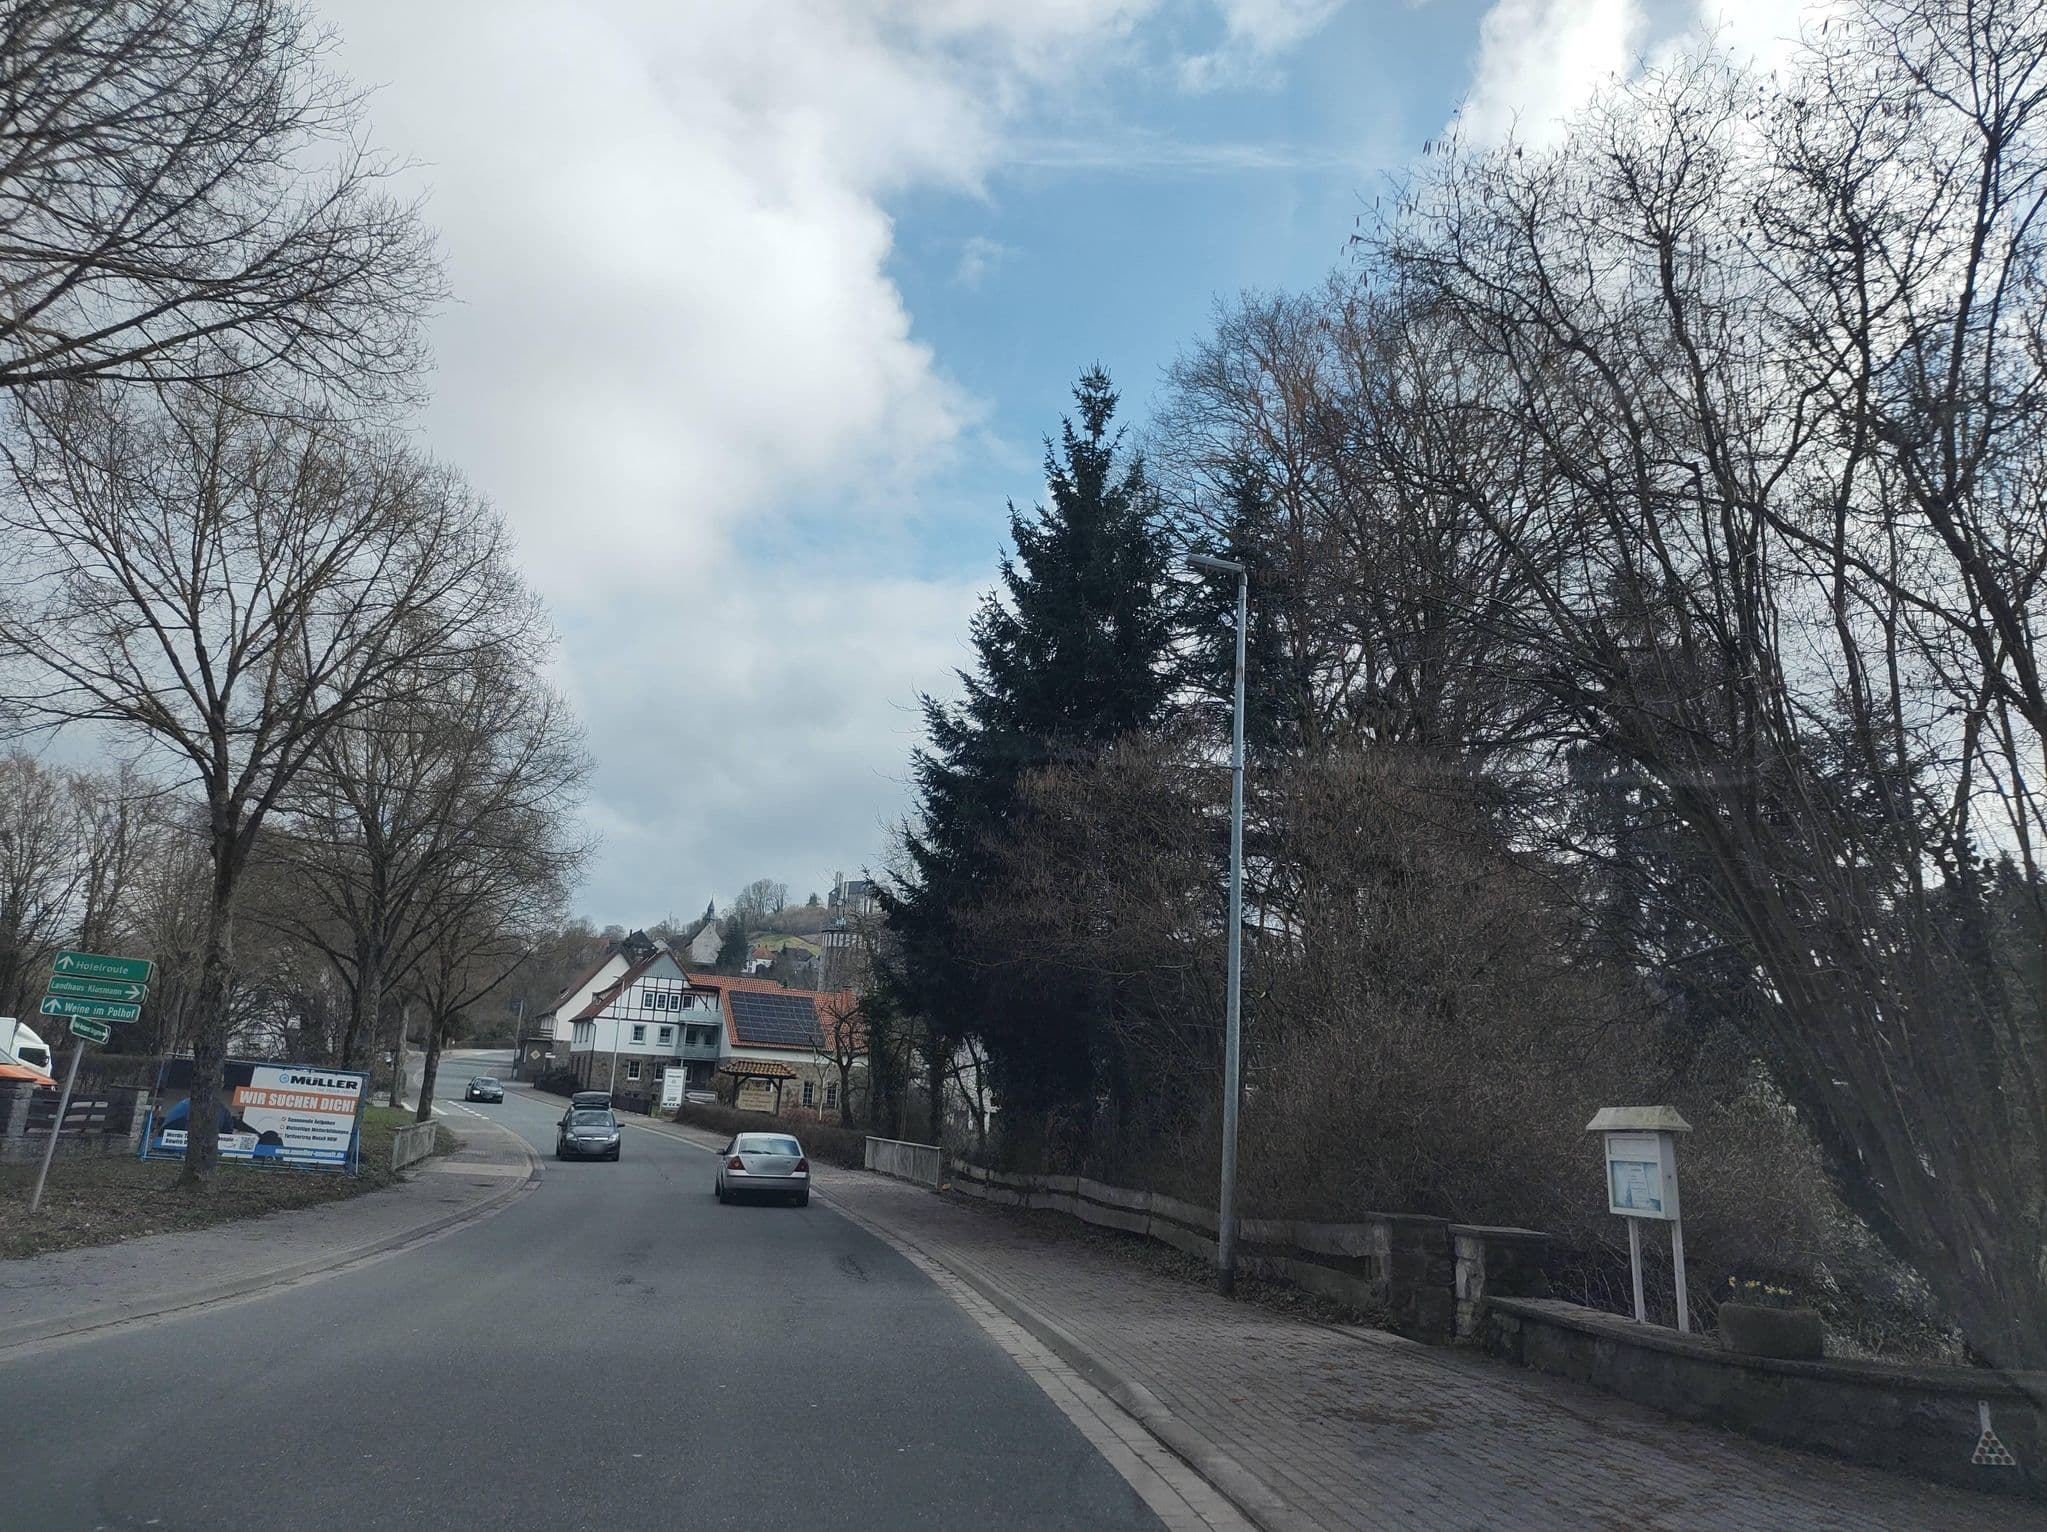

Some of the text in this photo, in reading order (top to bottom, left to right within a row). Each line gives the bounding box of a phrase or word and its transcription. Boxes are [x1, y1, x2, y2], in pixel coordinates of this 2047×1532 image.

[76, 962, 128, 975] Hotelroute
[51, 981, 85, 992] Landhaus
[64, 1003, 90, 1014] Weine
[93, 1007, 104, 1015] im
[290, 1075, 358, 1090] MÜLLER
[240, 1090, 356, 1113] WIR SUCHEN DICH!
